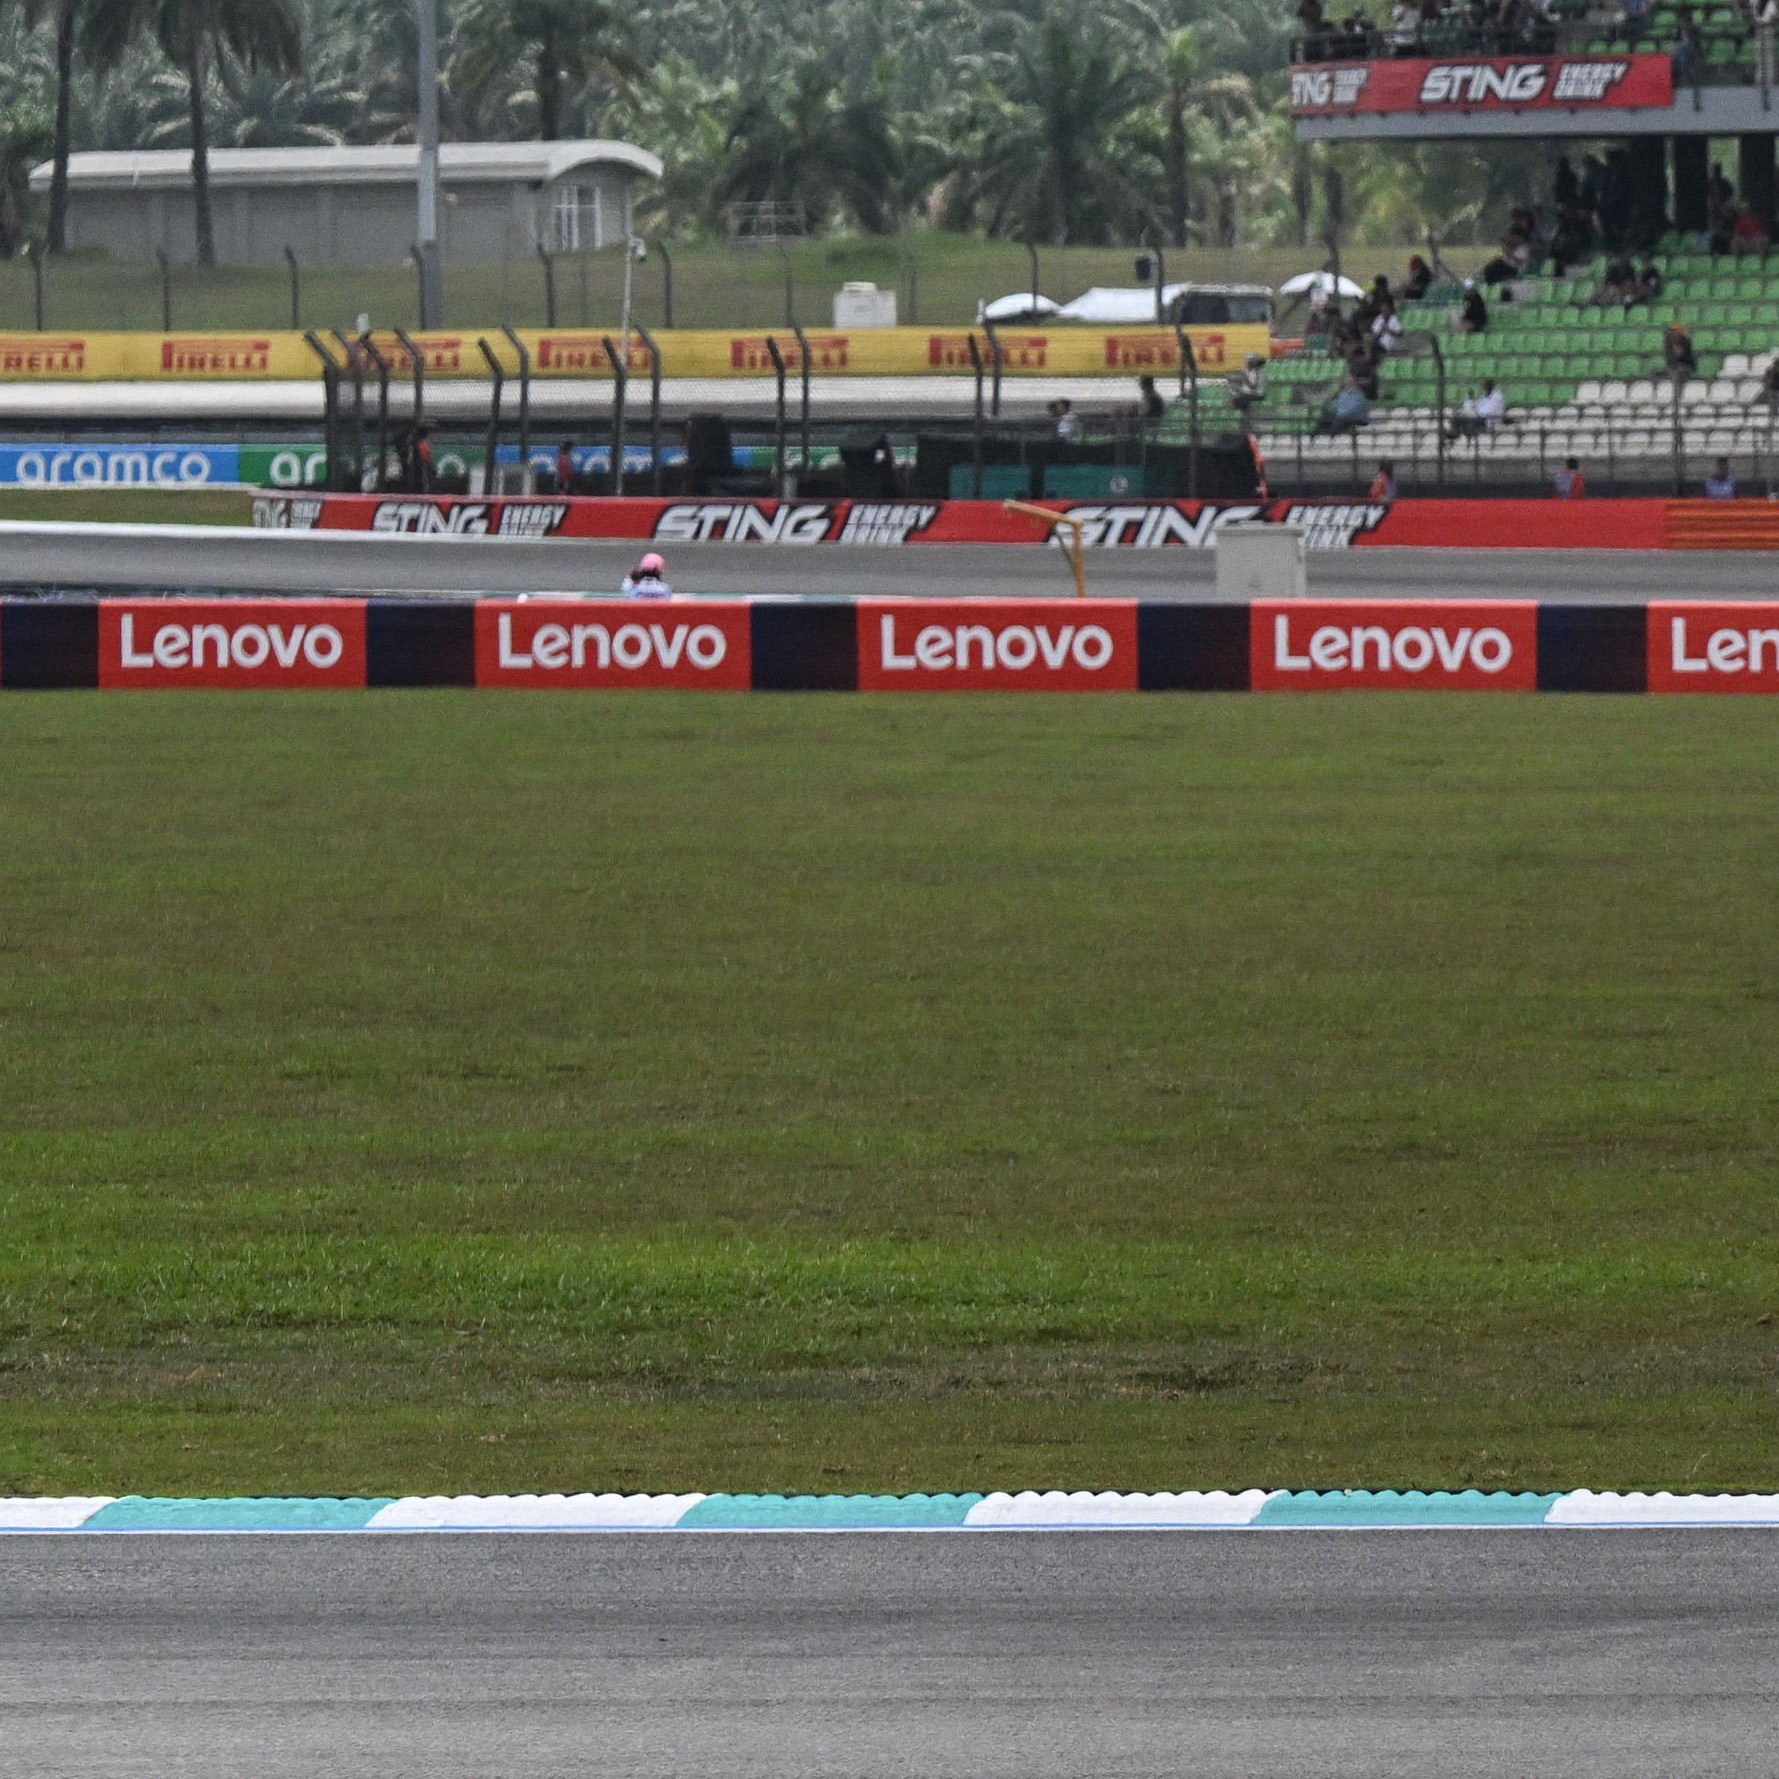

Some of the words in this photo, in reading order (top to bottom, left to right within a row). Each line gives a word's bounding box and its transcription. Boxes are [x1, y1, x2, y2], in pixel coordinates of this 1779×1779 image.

[1420, 64, 1546, 104] STING
[162, 339, 270, 371] PIRELLI
[16, 451, 211, 485] aramco
[372, 502, 489, 534] STING
[654, 504, 831, 544] STING
[848, 505, 937, 526] ENERGY
[1285, 505, 1386, 528] ENERGY
[121, 614, 342, 667] Lenovo
[499, 614, 726, 668] Lenovo
[882, 615, 1112, 669] Lenovo
[1276, 615, 1511, 671] Lenovo
